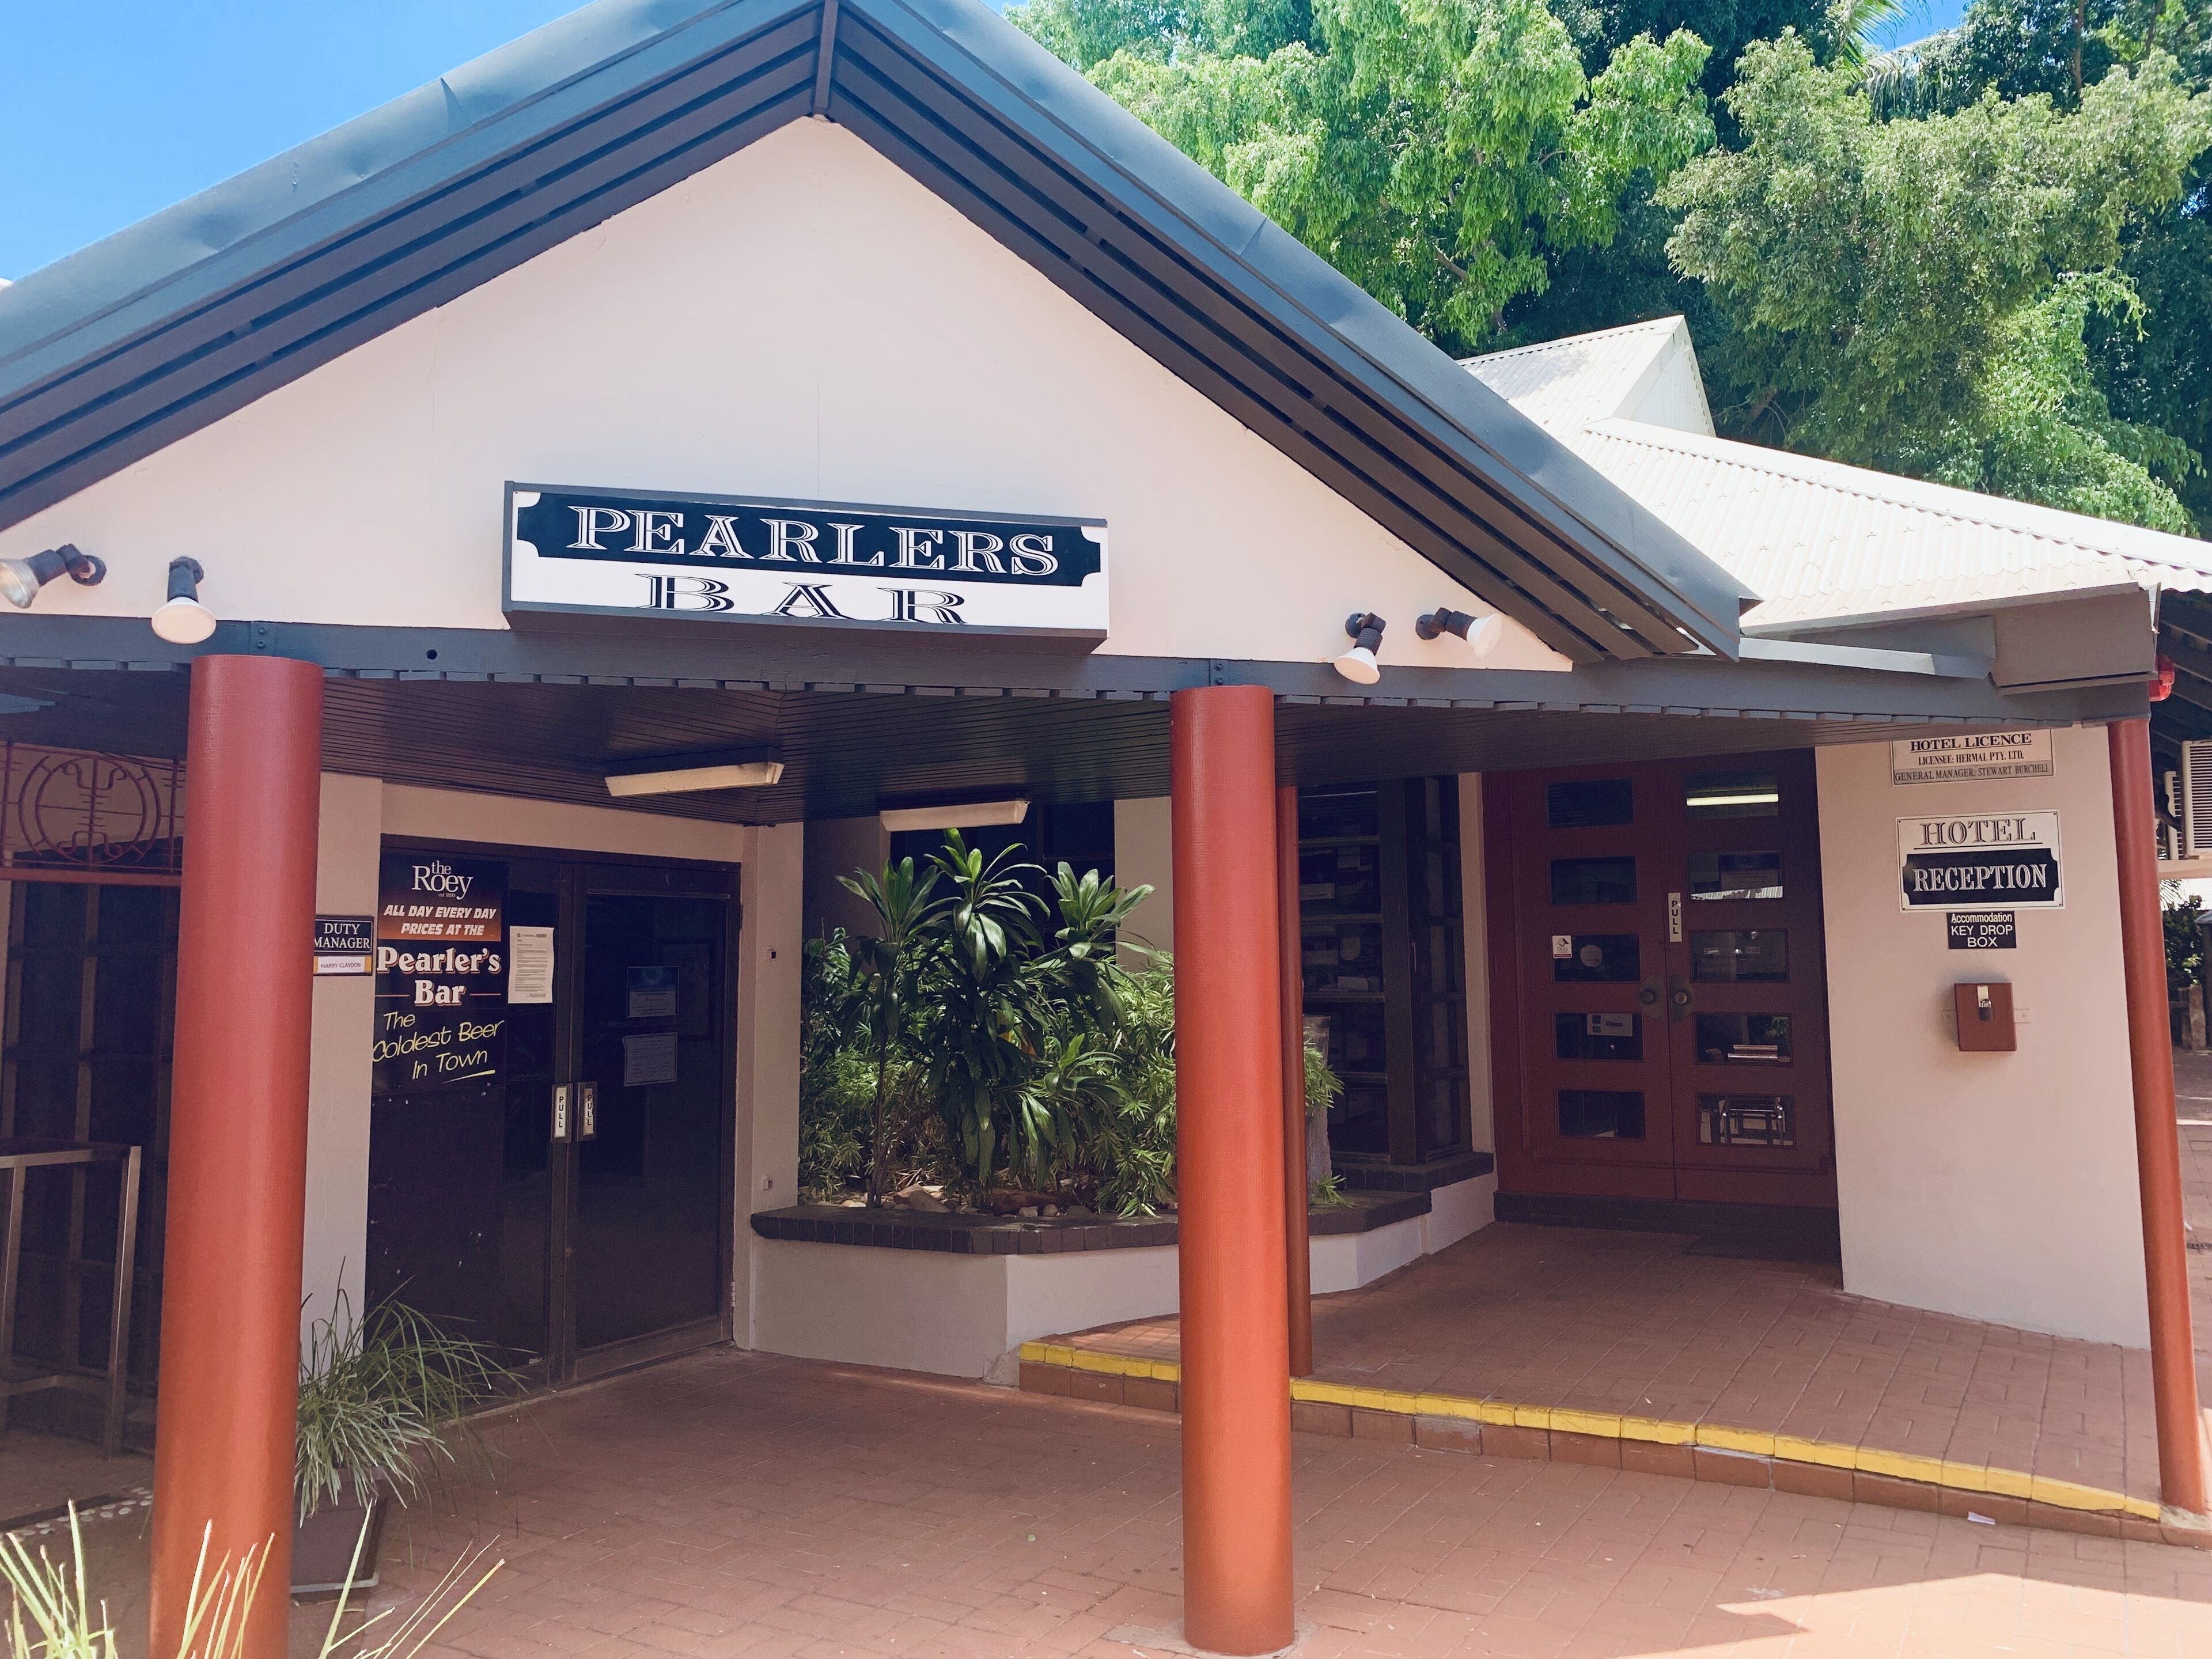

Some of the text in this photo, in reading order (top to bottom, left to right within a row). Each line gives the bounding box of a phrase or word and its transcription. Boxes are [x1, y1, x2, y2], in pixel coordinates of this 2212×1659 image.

[566, 505, 1059, 576] PEARLERS
[634, 573, 968, 624] BAR
[1911, 733, 2032, 751] HOTEL LICENCE
[1918, 750, 2024, 766] LICENSEE: HERMAL PTY. LTD.
[1895, 770, 1936, 782] GENERAL
[1978, 766, 2012, 777] STEWART
[2015, 763, 2049, 774] BURCHELL
[1919, 818, 2036, 846] HOTEL
[431, 860, 452, 875] the
[411, 865, 474, 900] Roey
[1912, 863, 2048, 892] RECEPTION
[383, 904, 497, 919] ALL DAY EVERY DAY
[1951, 913, 2013, 923] Accommodation
[323, 923, 361, 935] DUTY
[400, 923, 485, 935] PRICES AT THE
[1951, 925, 2013, 935] KEY DROP
[314, 937, 370, 949] MANAGER
[1967, 937, 1998, 948] BOX
[376, 946, 502, 974] Pearler's
[414, 979, 467, 1006] Bar
[383, 1011, 415, 1031] The
[373, 1020, 505, 1062] Coldest Beer
[412, 1050, 487, 1080] In Town
